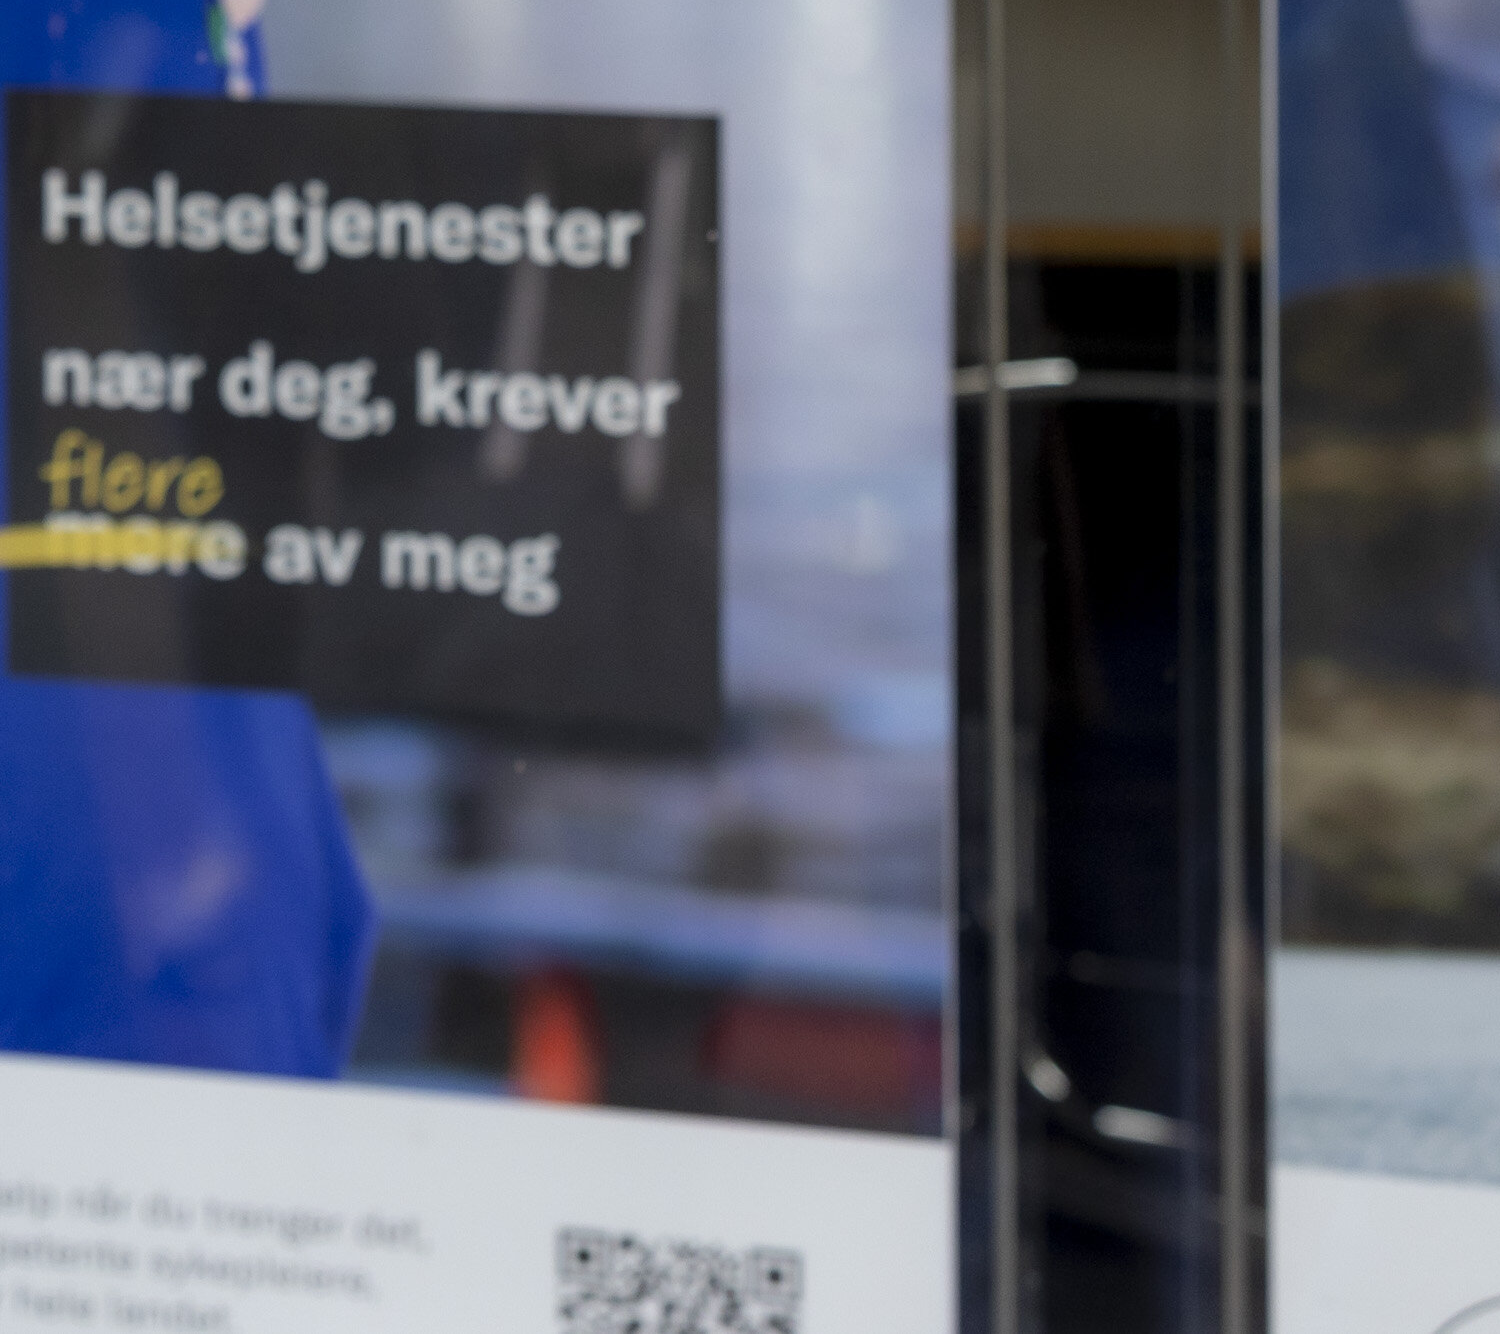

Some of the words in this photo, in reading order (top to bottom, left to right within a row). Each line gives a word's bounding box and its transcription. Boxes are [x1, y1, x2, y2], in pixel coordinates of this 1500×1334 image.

[42, 168, 643, 272] Helsetjenester
[42, 348, 205, 412] nær
[220, 339, 395, 440] deg,
[416, 348, 681, 435] krever
[40, 428, 224, 516] flere
[263, 523, 363, 585] av
[381, 532, 561, 616] meg
